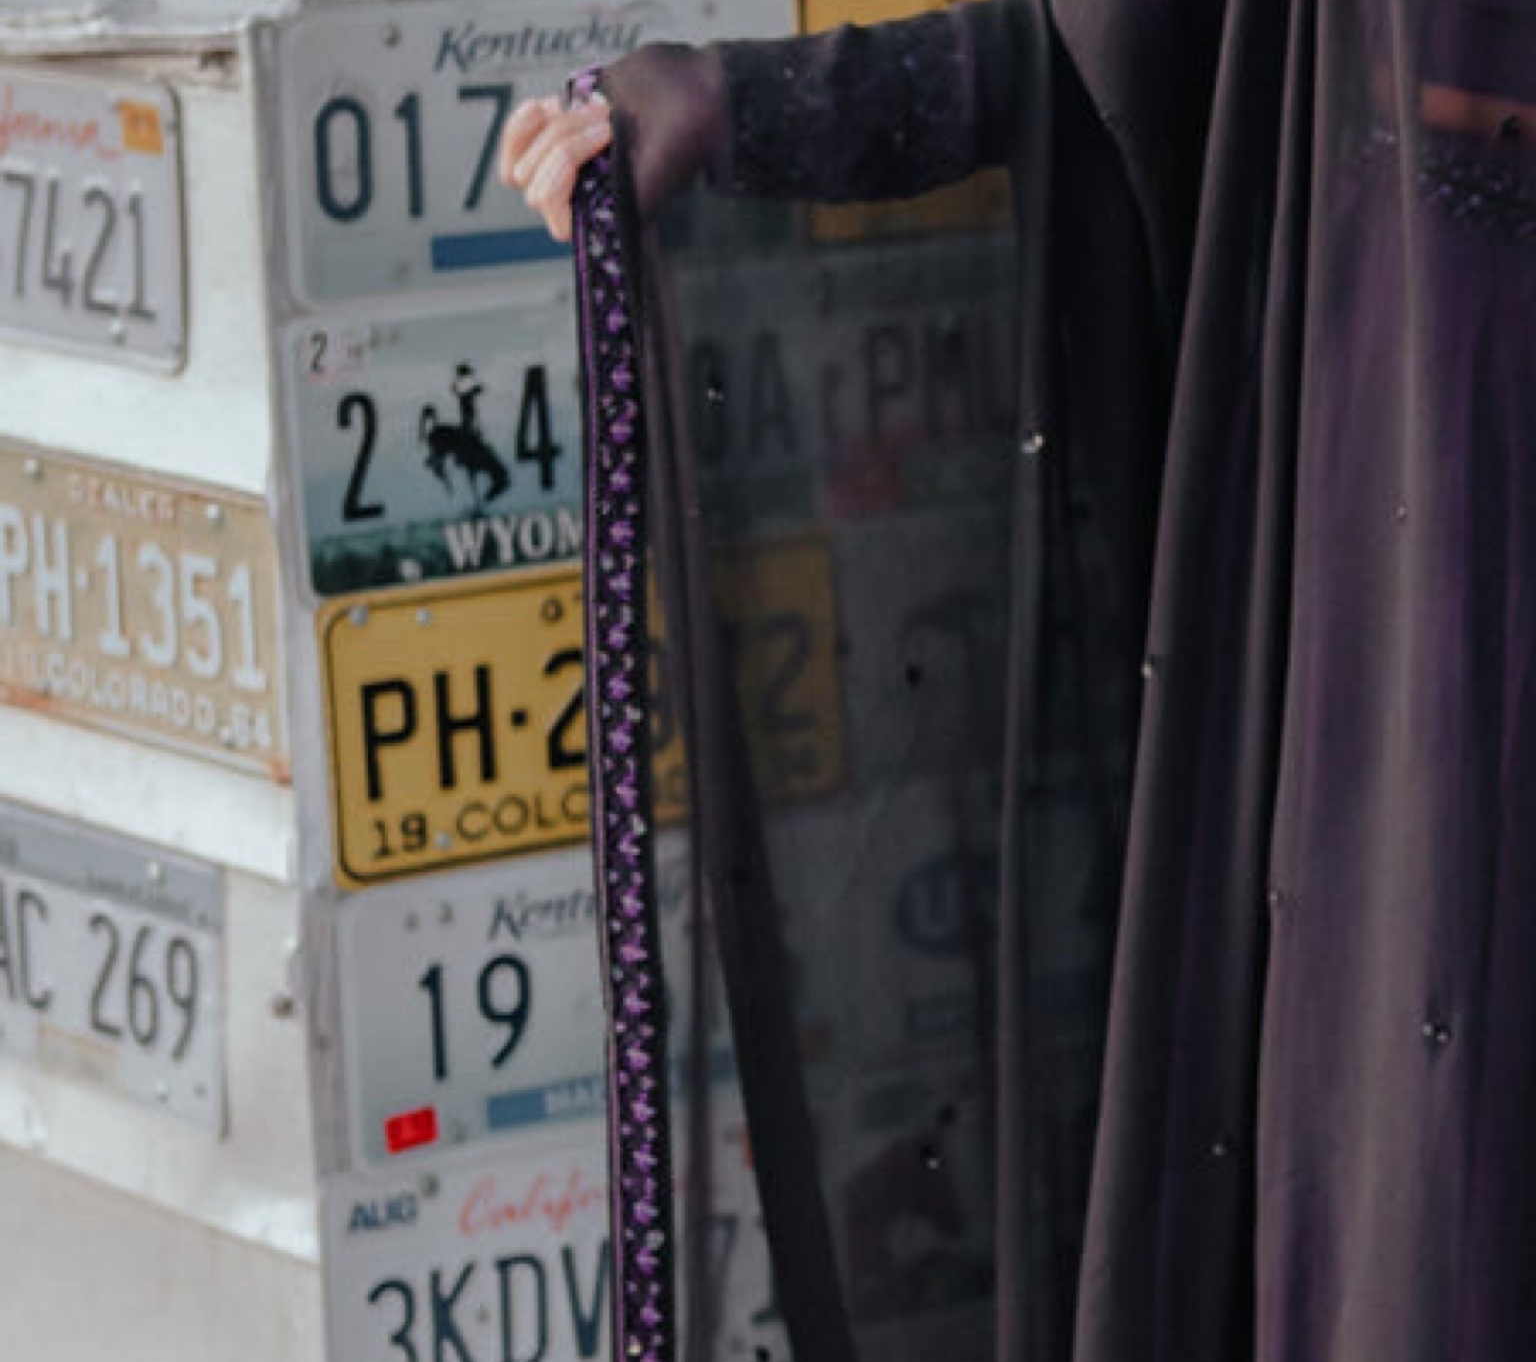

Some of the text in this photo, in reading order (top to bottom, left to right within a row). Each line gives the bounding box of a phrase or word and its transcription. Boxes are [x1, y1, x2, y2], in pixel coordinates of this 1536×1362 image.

[434, 16, 643, 72] Kentucky
[313, 85, 514, 222] 017
[47, 652, 219, 736] COLORADO
[374, 812, 428, 857] 19
[88, 912, 198, 1062] 269
[418, 954, 532, 1080] 19
[348, 1192, 418, 1232] AUG
